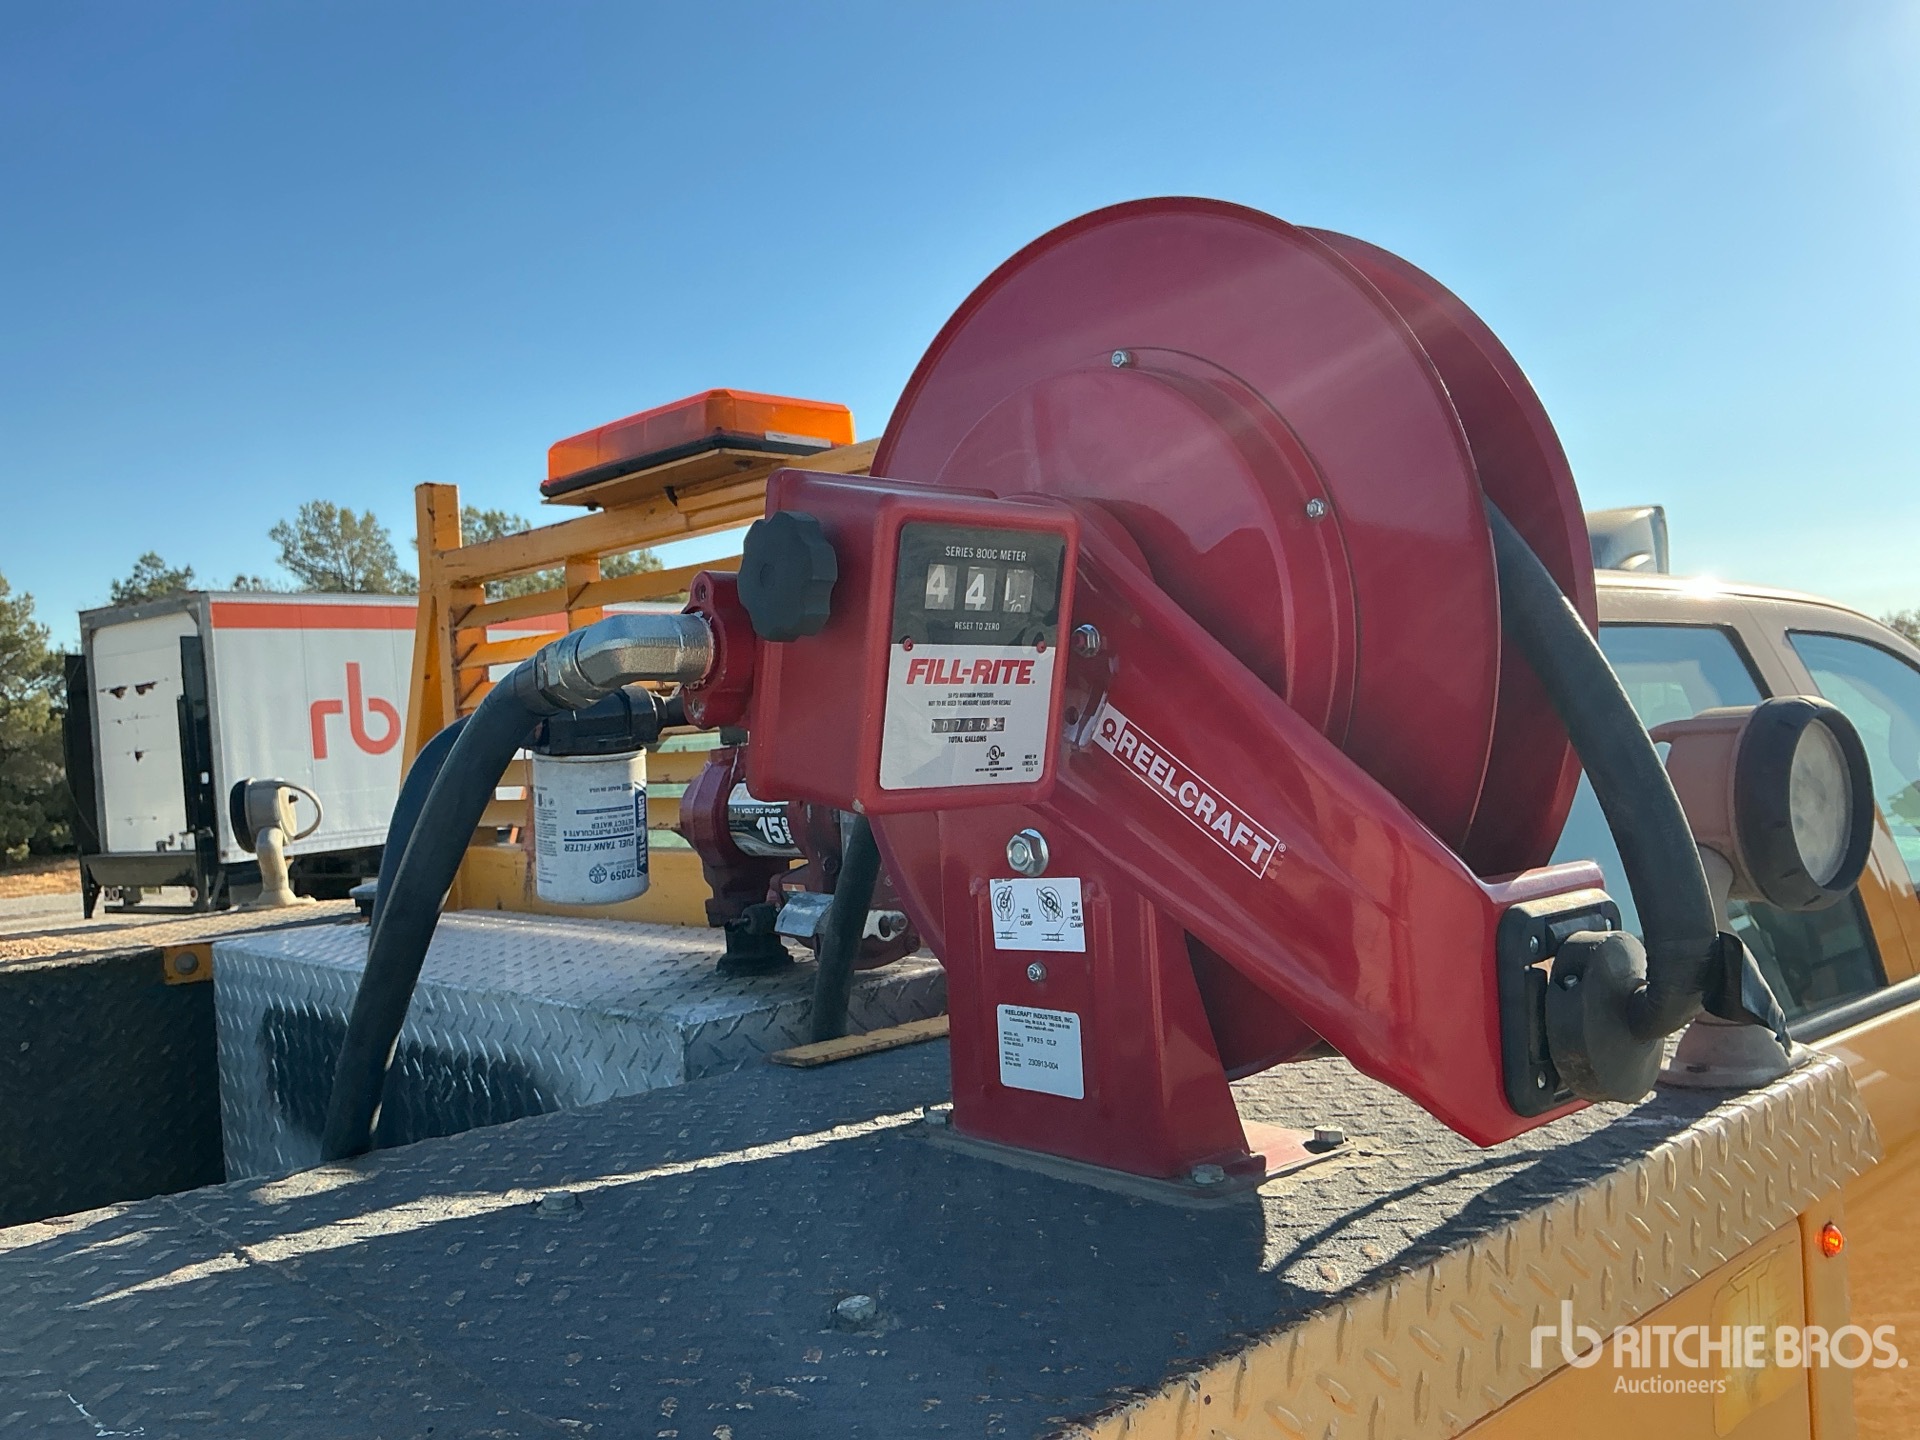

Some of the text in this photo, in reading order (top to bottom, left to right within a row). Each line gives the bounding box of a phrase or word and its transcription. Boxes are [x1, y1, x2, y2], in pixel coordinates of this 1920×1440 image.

[945, 546, 1027, 562] SERIES 800C METER
[954, 621, 1000, 631] RESET TO ZERO
[906, 658, 1035, 685] FILL-RITE
[309, 661, 401, 760] rb
[948, 736, 963, 744] TOTAL
[1117, 729, 1272, 865] REELCRAFT
[591, 822, 613, 830] WATER
[756, 816, 786, 845] 15
[780, 816, 795, 845] GPM
[564, 842, 592, 852] FILTER
[594, 840, 616, 851] TANK
[619, 838, 635, 848] FUEL
[610, 868, 636, 881] 72059
[1004, 1009, 1032, 1018] REELCRAFT
[1032, 1012, 1064, 1024] INDUSTRIES,
